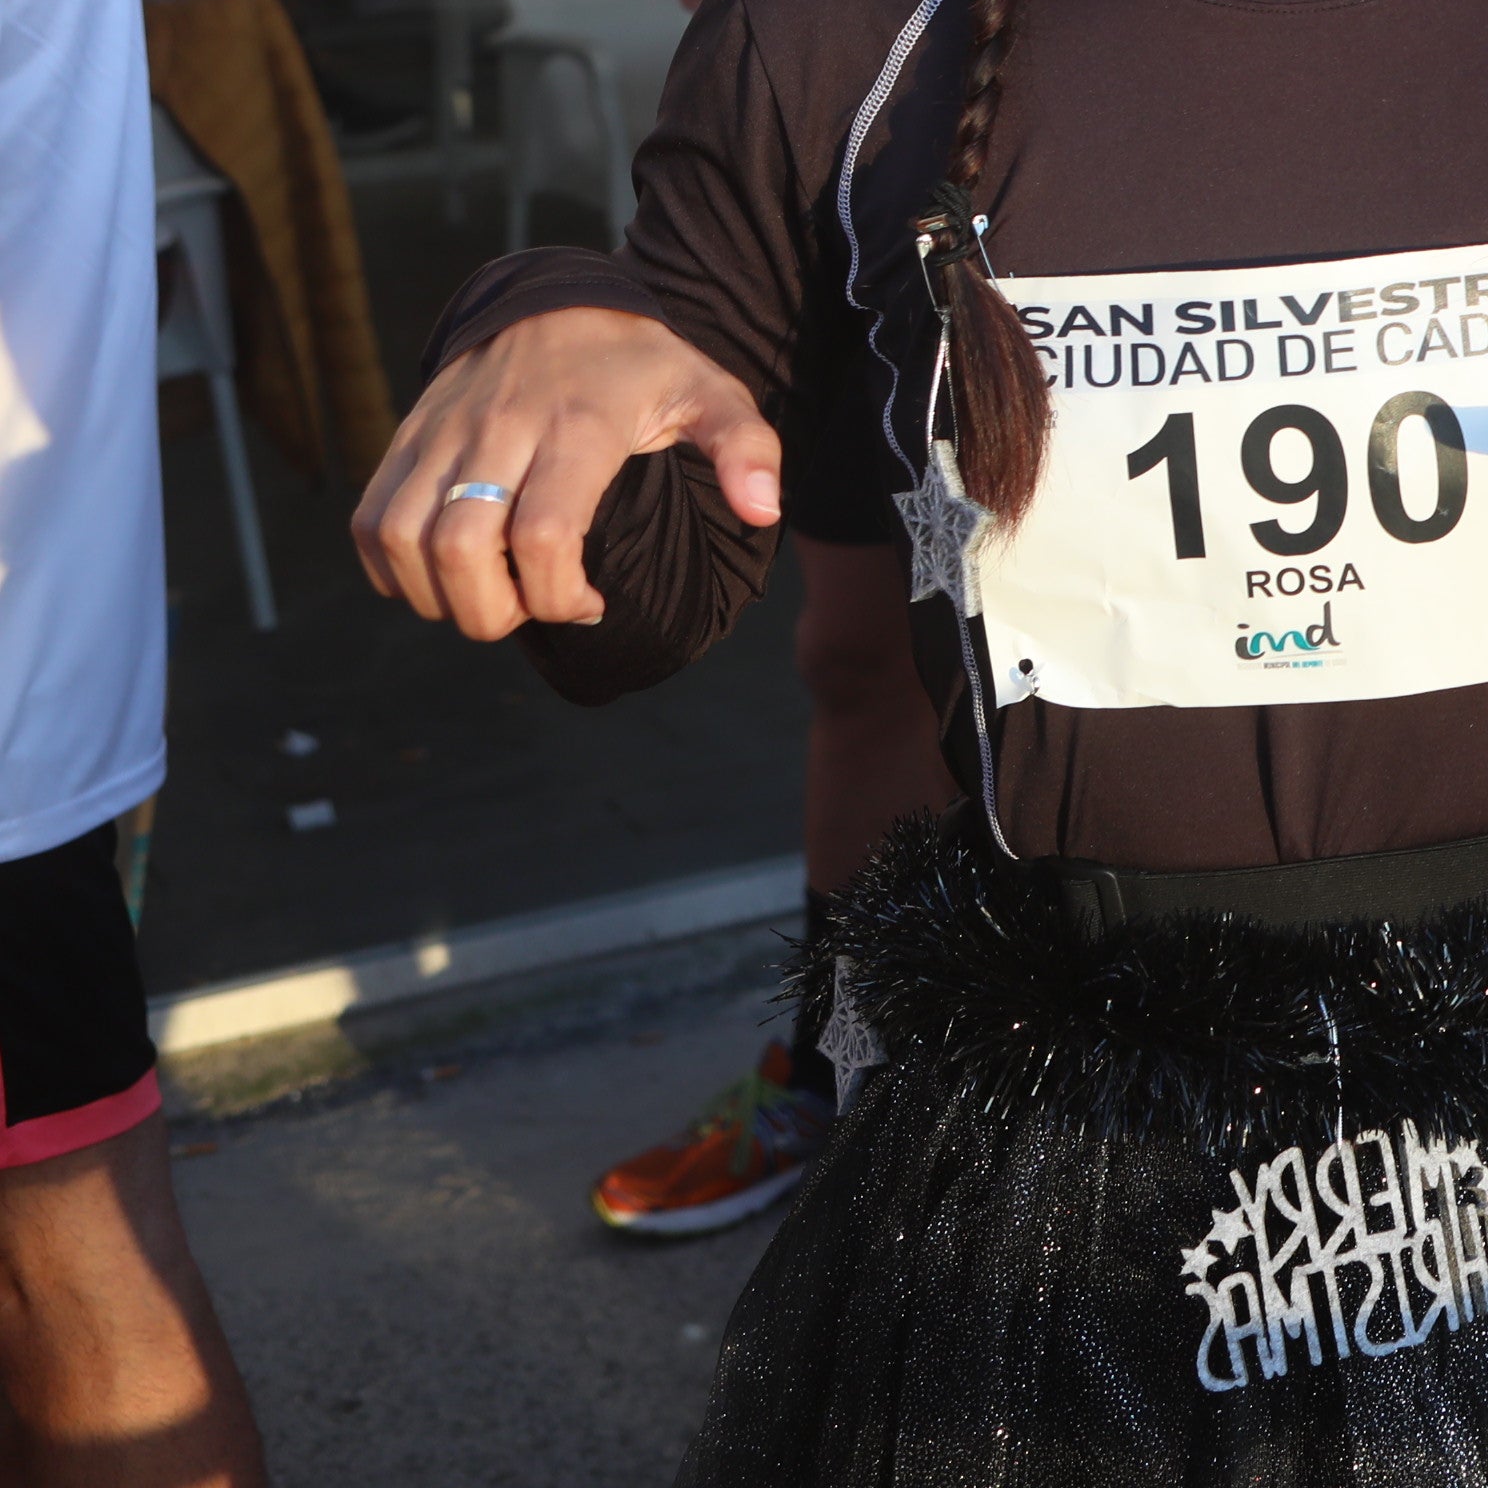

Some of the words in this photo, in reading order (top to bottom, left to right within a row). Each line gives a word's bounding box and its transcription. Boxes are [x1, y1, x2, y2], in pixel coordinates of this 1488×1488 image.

[1017, 303, 1154, 340] SAN
[1276, 328, 1358, 378] DE
[1126, 389, 1470, 561] 190
[1246, 562, 1366, 599] ROSA
